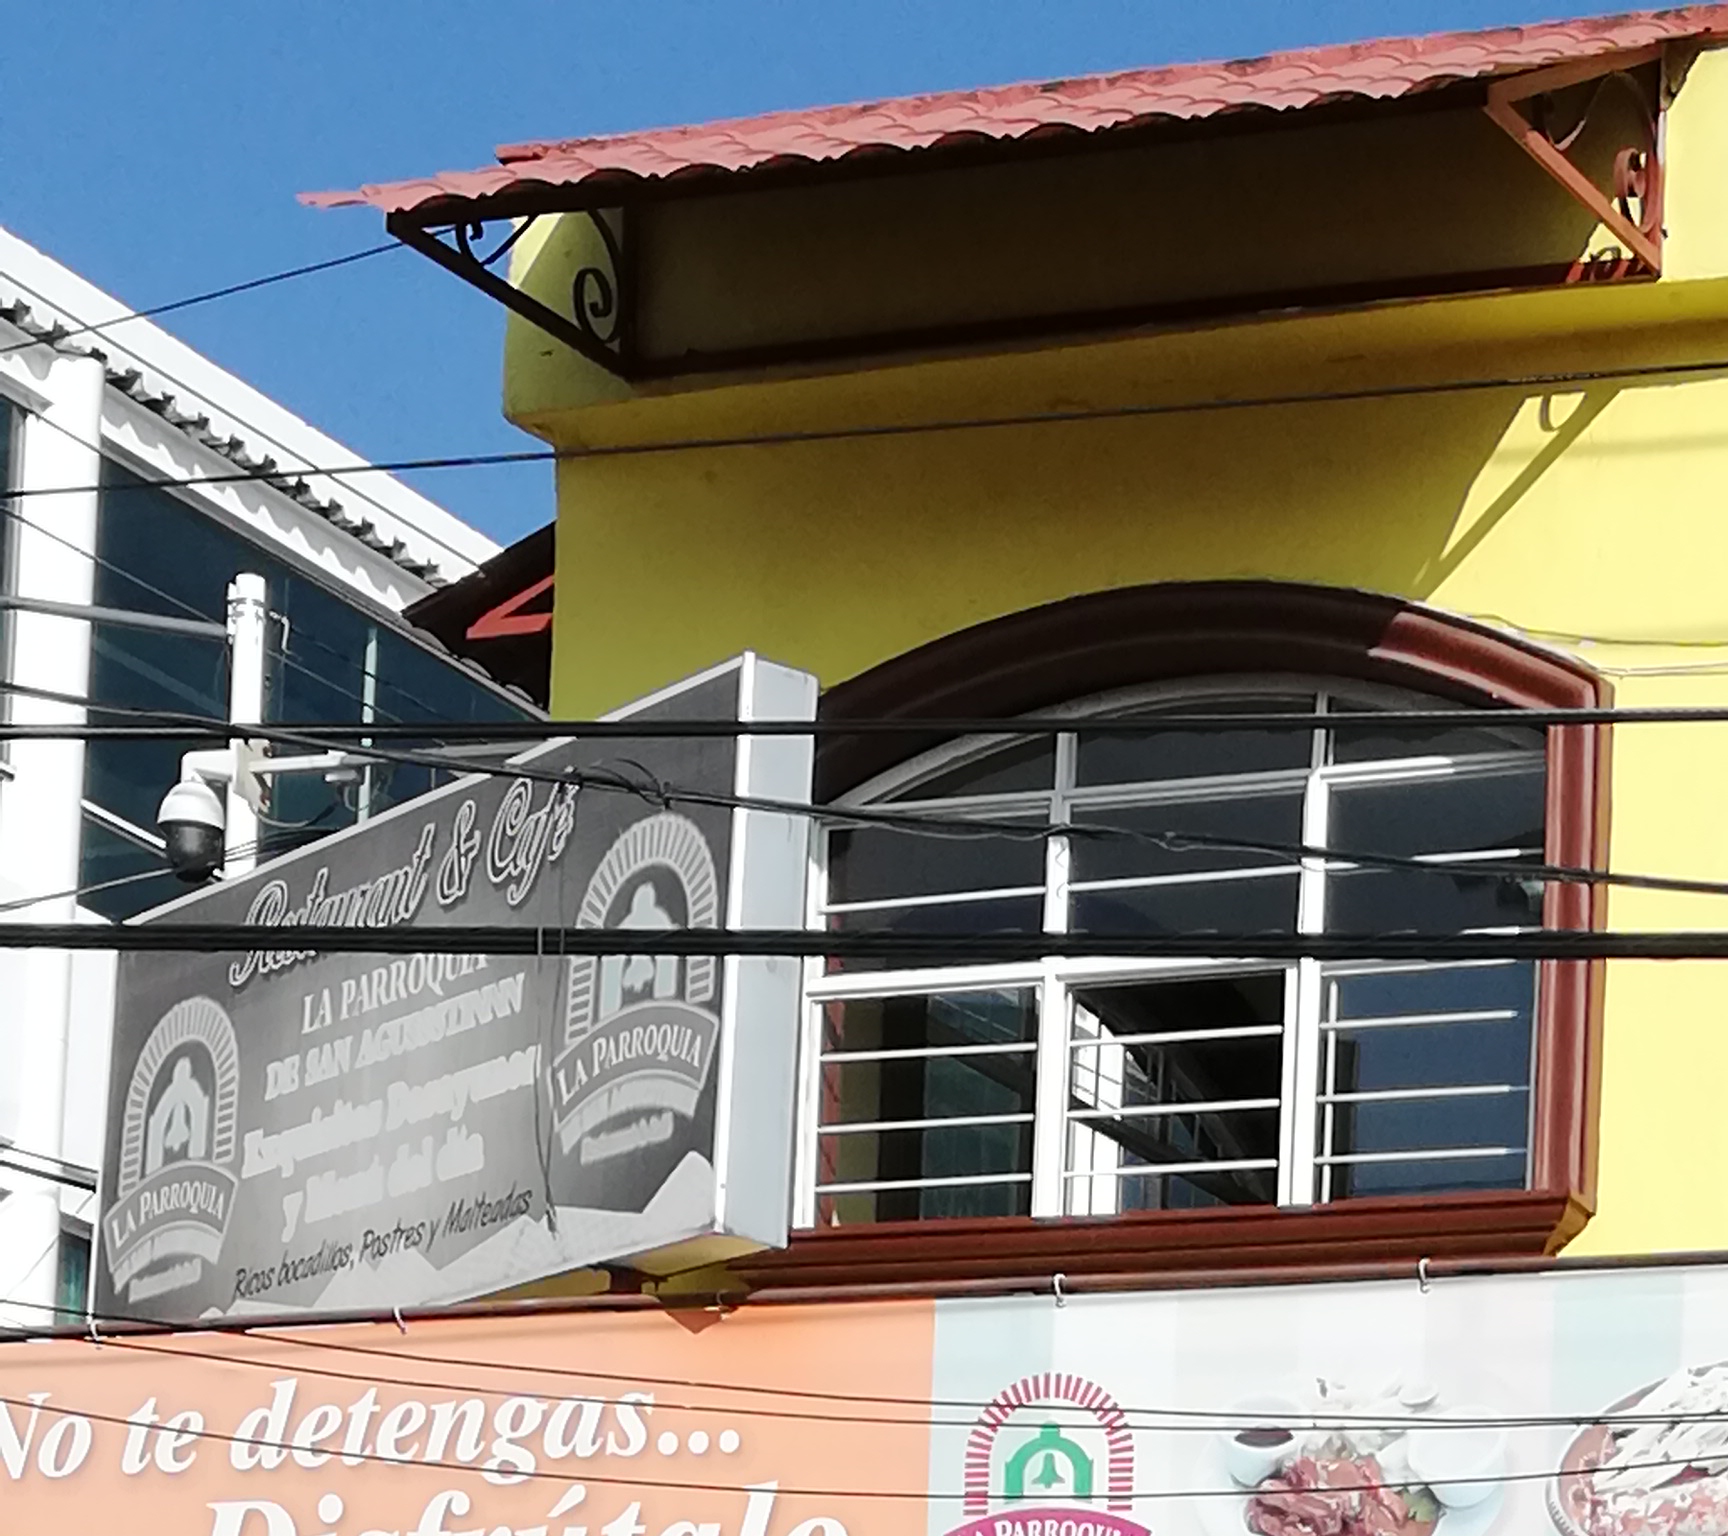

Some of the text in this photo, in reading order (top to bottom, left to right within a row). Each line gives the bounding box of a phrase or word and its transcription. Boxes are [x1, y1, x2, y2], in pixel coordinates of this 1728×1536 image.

[436, 799, 483, 906] &
[301, 953, 490, 1035] LA PARROQUIA
[304, 1035, 353, 1087] SAN
[555, 1023, 703, 1106] LA PARROQUIA
[111, 1180, 225, 1250] LA PARROQUIA
[232, 1267, 277, 1299] Ricos
[358, 1218, 427, 1264] Postres
[424, 1217, 442, 1253] y
[442, 1180, 533, 1239] Malteadas
[121, 1396, 203, 1476] te
[228, 1377, 741, 1486] detengas...
